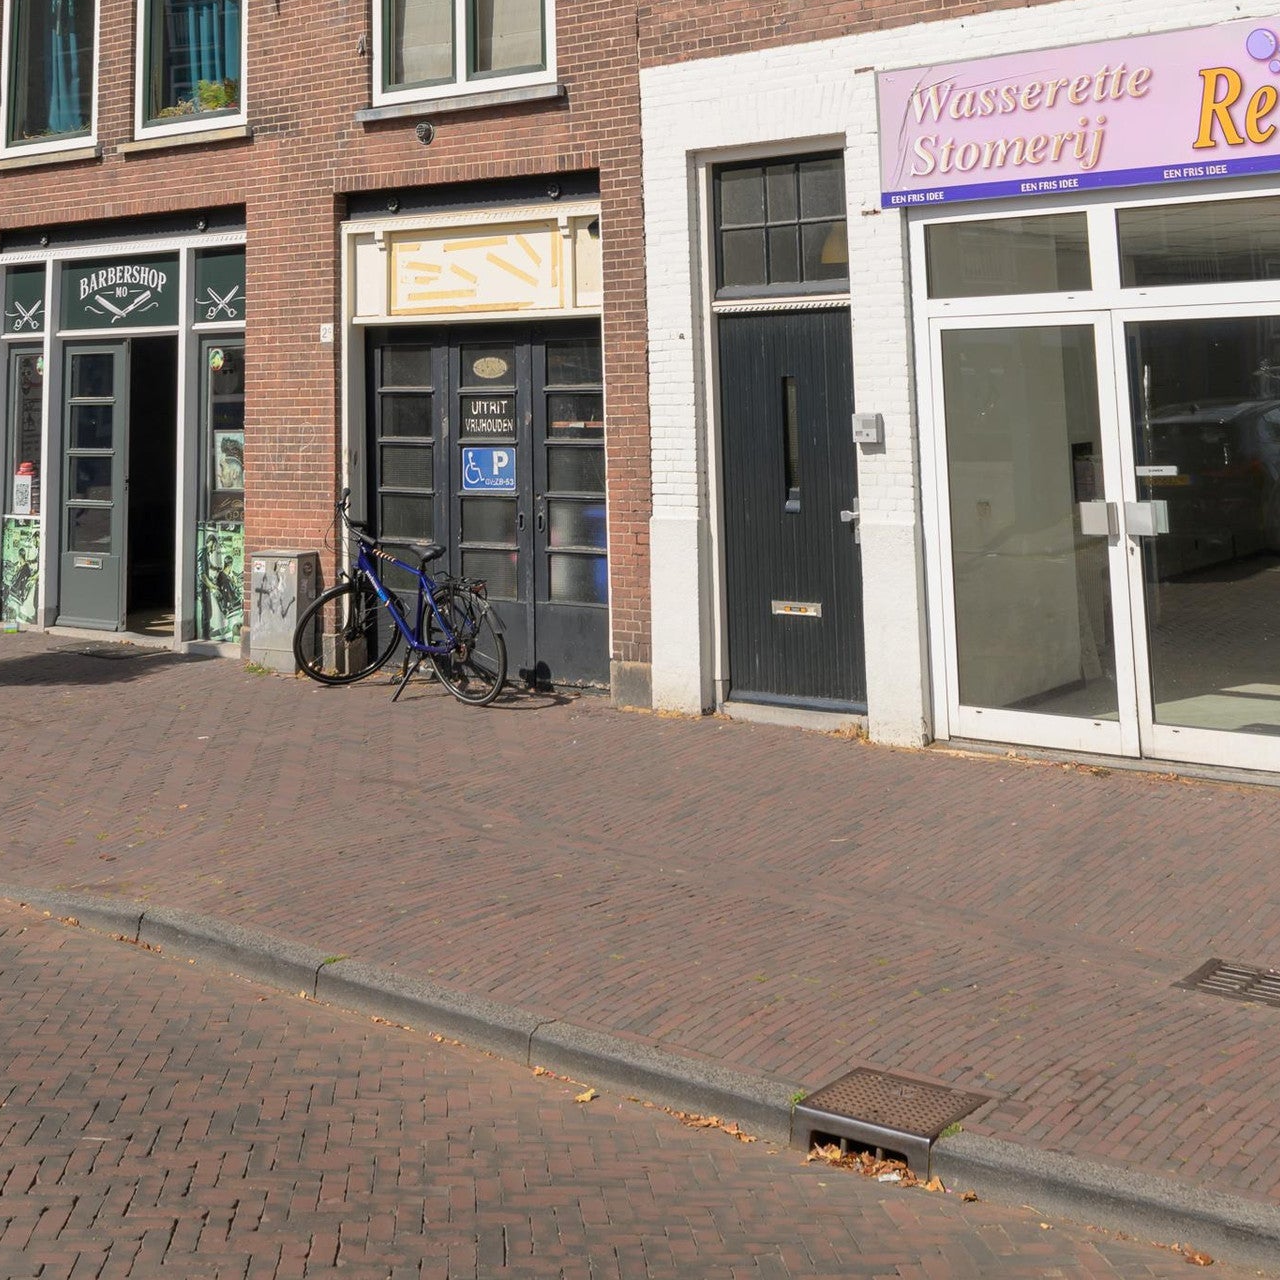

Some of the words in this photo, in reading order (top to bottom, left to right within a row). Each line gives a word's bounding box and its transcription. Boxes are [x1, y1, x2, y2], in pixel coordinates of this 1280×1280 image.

[910, 62, 1153, 124] Wasserette
[909, 115, 1108, 178] Stomerij
[1163, 168, 1182, 180] EEN
[1183, 167, 1204, 178] FRIS
[1205, 164, 1228, 176] IDEE
[1021, 182, 1039, 193] EEN
[1039, 181, 1059, 191] FRIS
[1059, 178, 1080, 189] IDEE
[891, 195, 907, 205] EEN
[907, 194, 926, 203] FRIS
[926, 191, 945, 202] IDEE
[79, 265, 167, 300] BARBERSHOP
[115, 287, 128, 298] MO
[471, 400, 508, 415] UITRIT
[465, 418, 513, 432] VRIJHOUDEN
[492, 450, 509, 475] P
